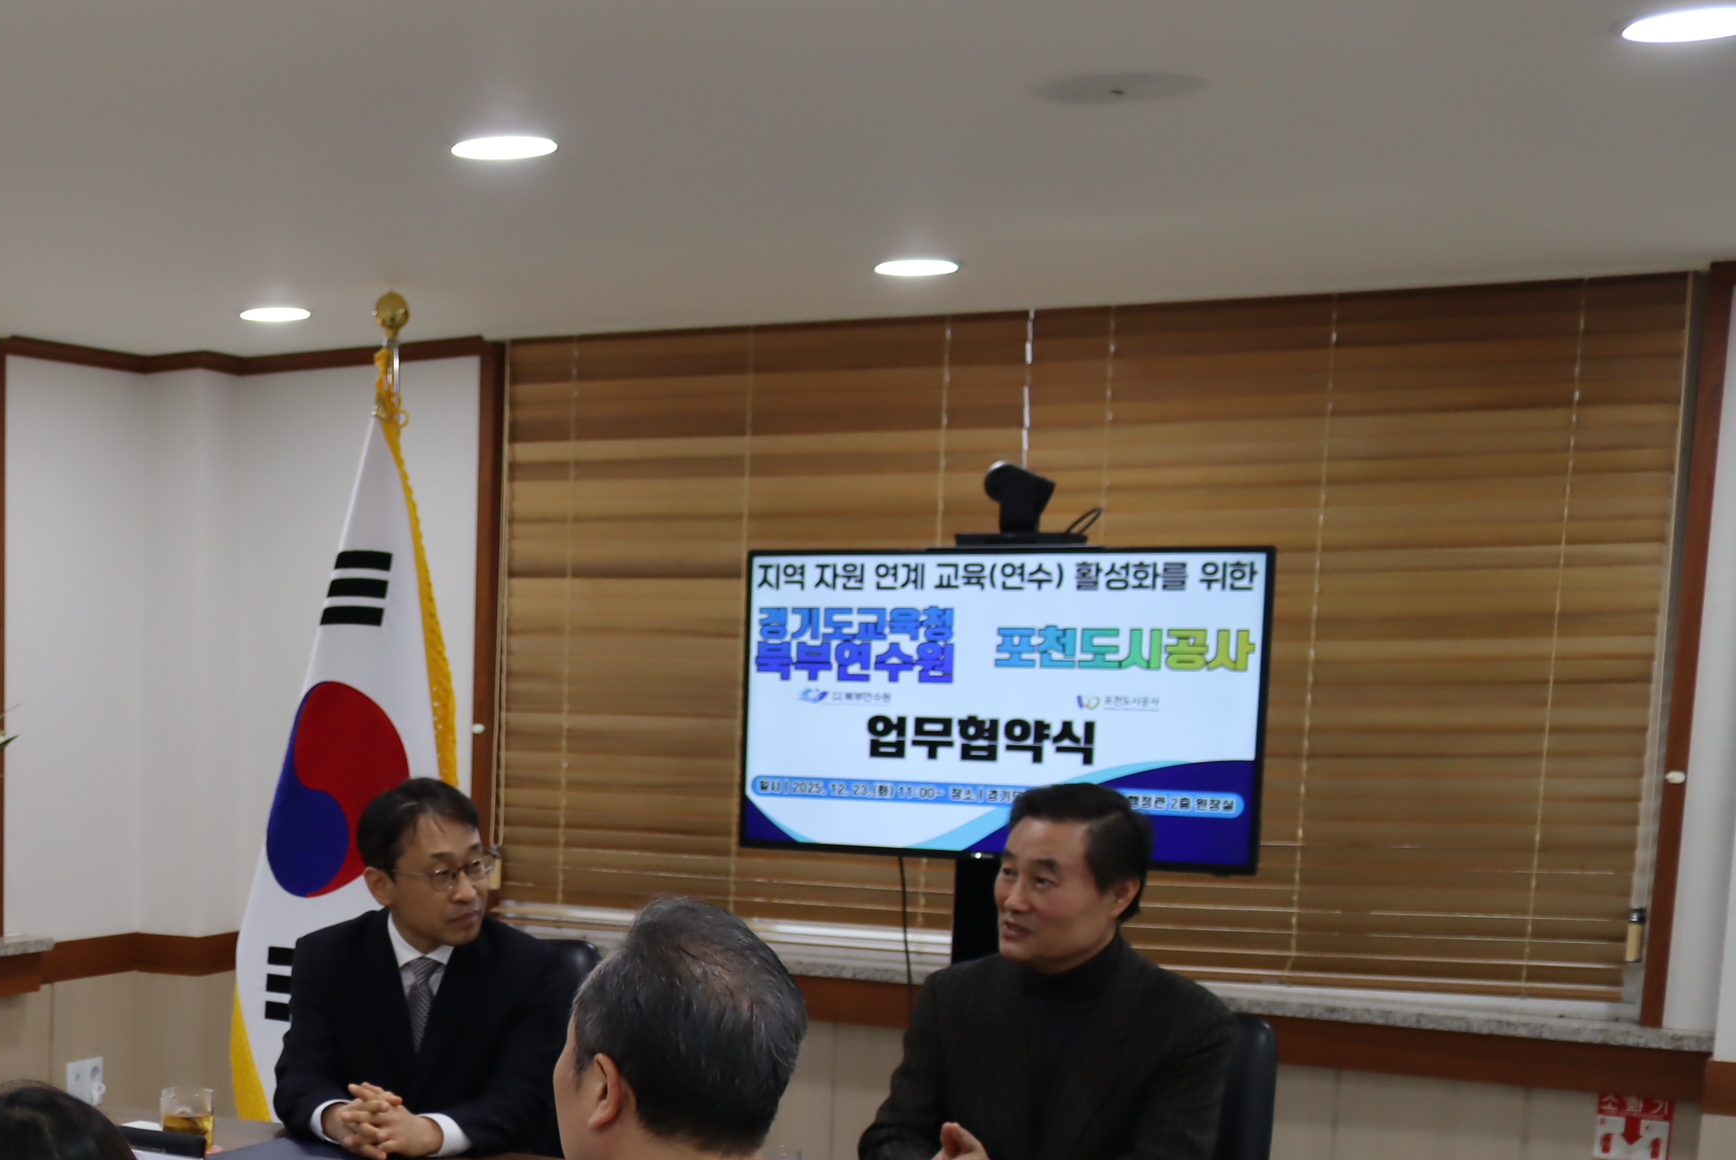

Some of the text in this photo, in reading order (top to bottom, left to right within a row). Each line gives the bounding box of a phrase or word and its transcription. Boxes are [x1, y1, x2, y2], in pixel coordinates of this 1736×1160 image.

[758, 561, 1258, 592] 지역 자원 연계 교육(연수) 활성화를 위한
[758, 605, 955, 642] 경기도교육청
[755, 640, 955, 683] 북부연수원
[993, 624, 1256, 671] 포천도시공사
[866, 715, 1097, 766] 업무협약식
[792, 781, 827, 795] 2025.
[831, 783, 849, 797] 12.
[951, 787, 976, 801] 장소
[1600, 1095, 1670, 1115] 소화기
